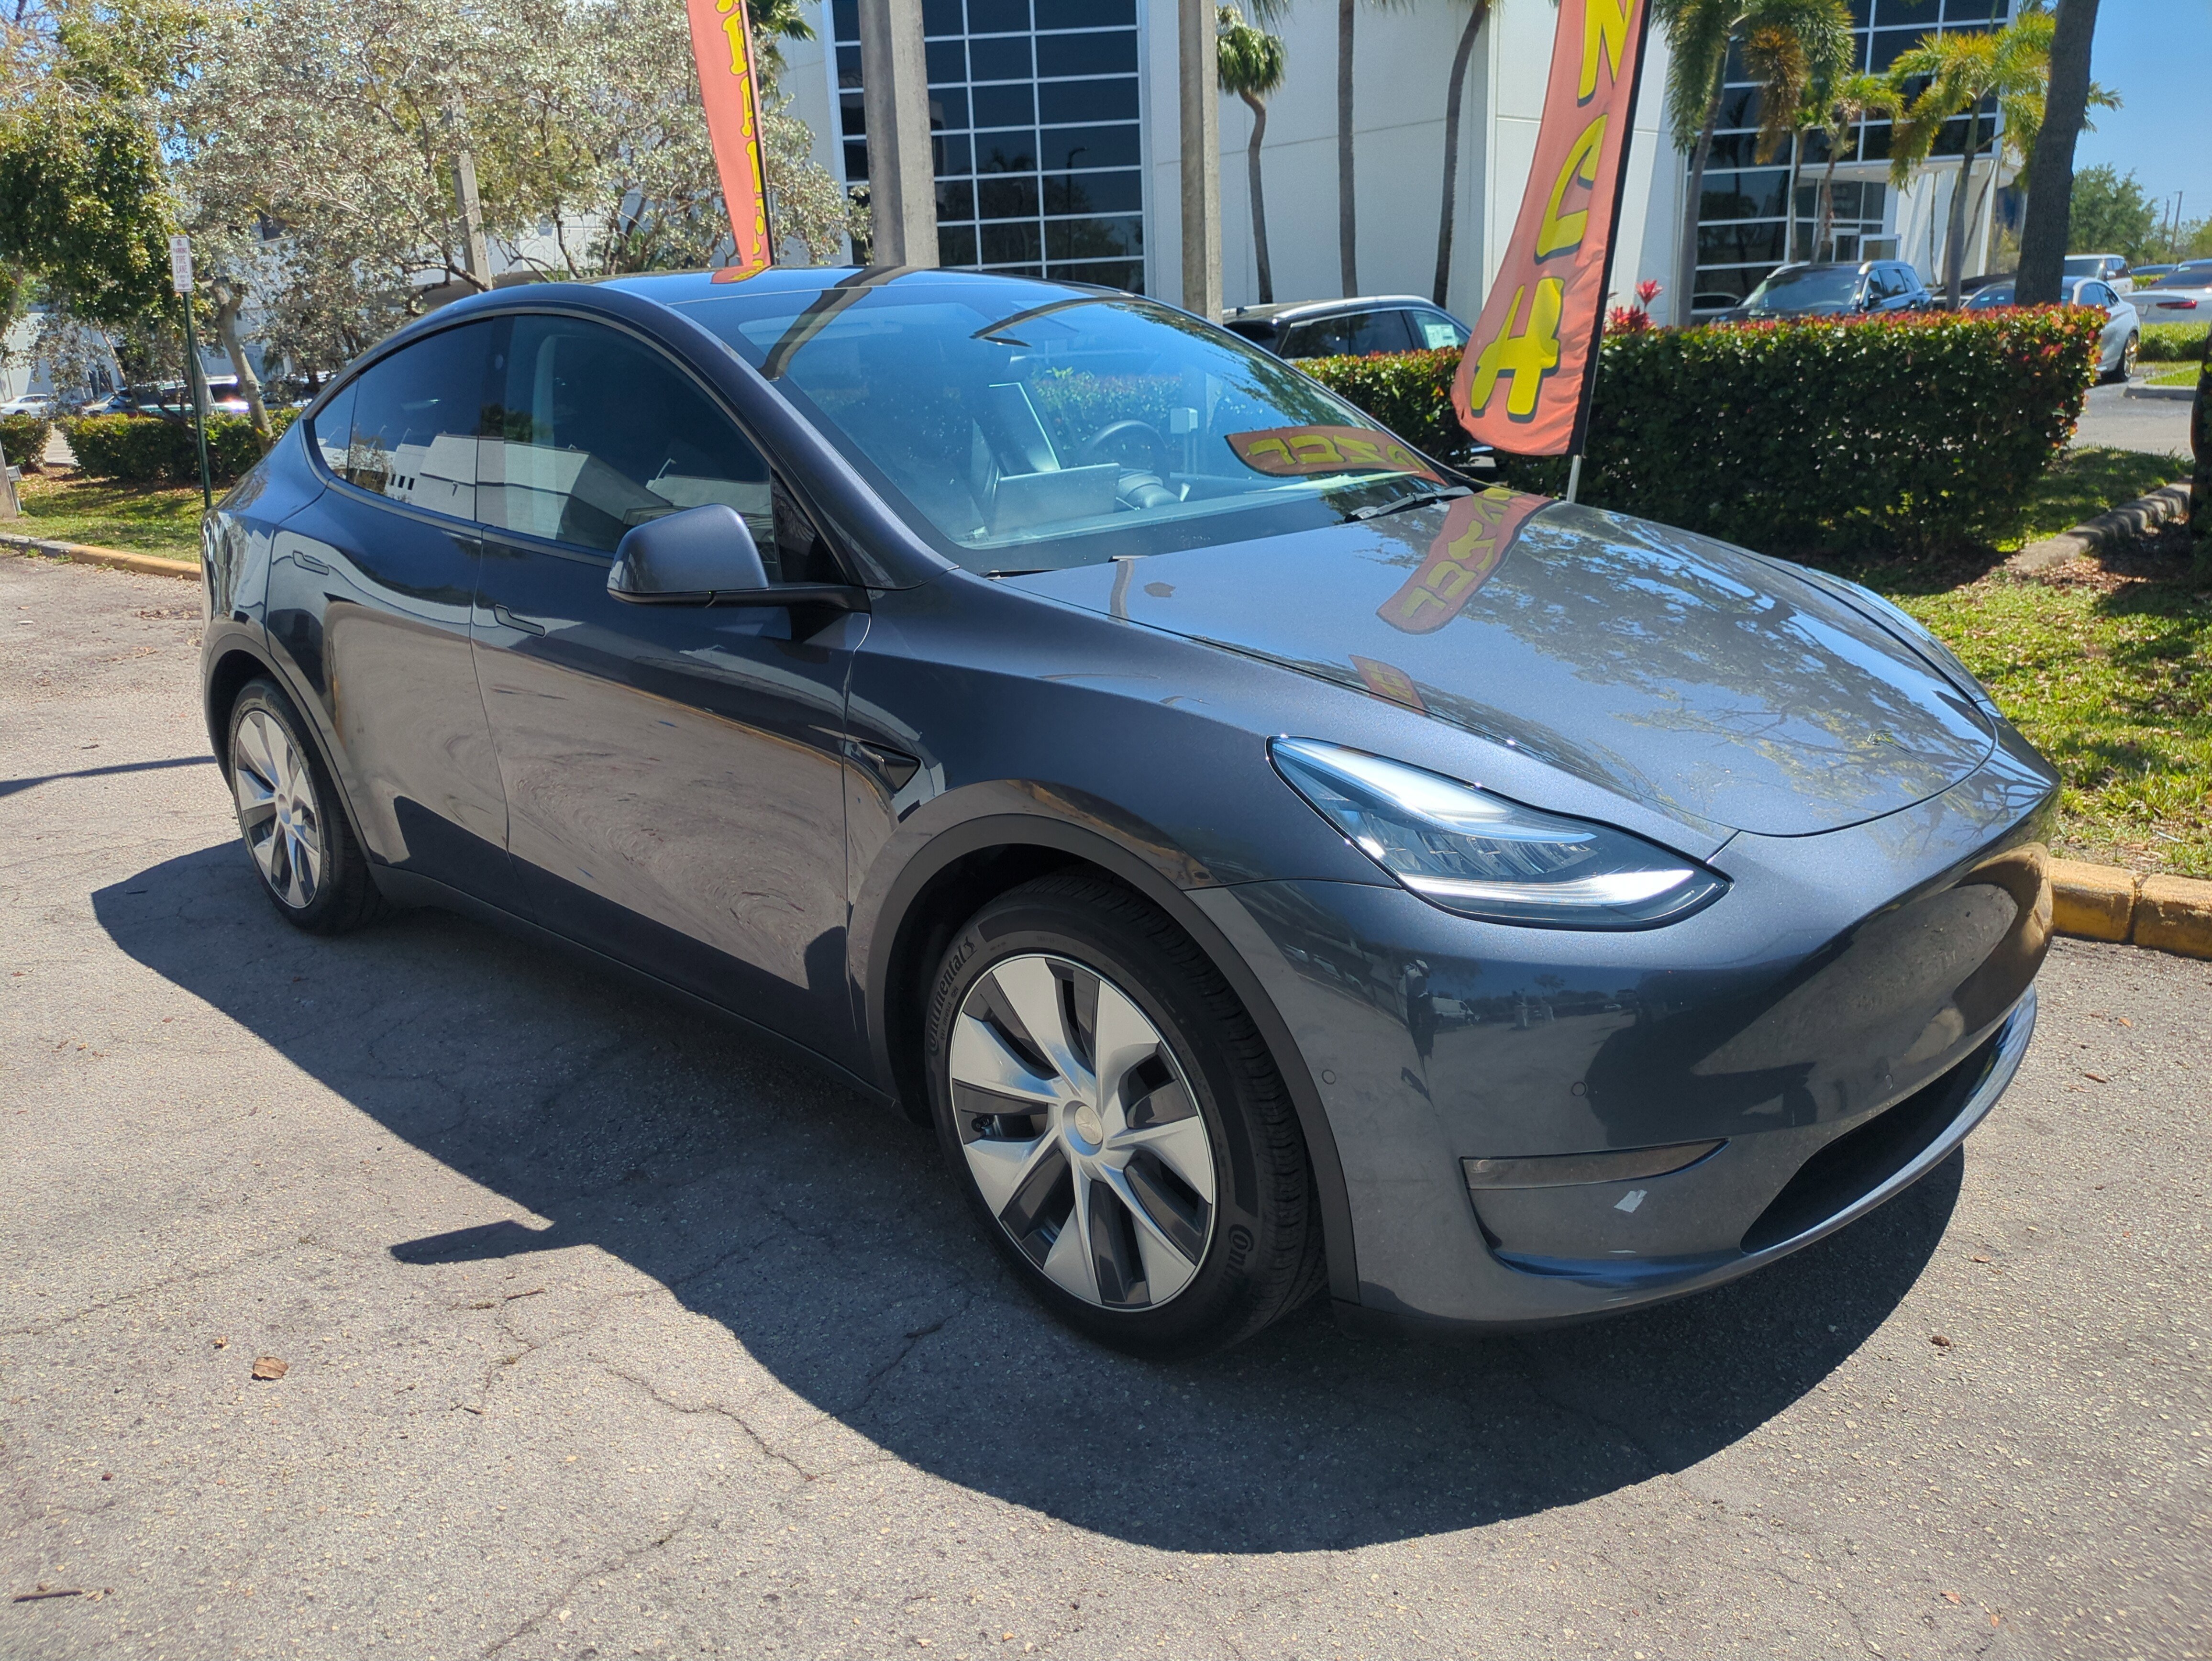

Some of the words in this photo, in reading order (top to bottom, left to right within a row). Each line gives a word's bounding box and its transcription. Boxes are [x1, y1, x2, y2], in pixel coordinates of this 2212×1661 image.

[176, 255, 186, 264] FIRE
[176, 265, 188, 274] LANE
[928, 944, 967, 1055] Continental
